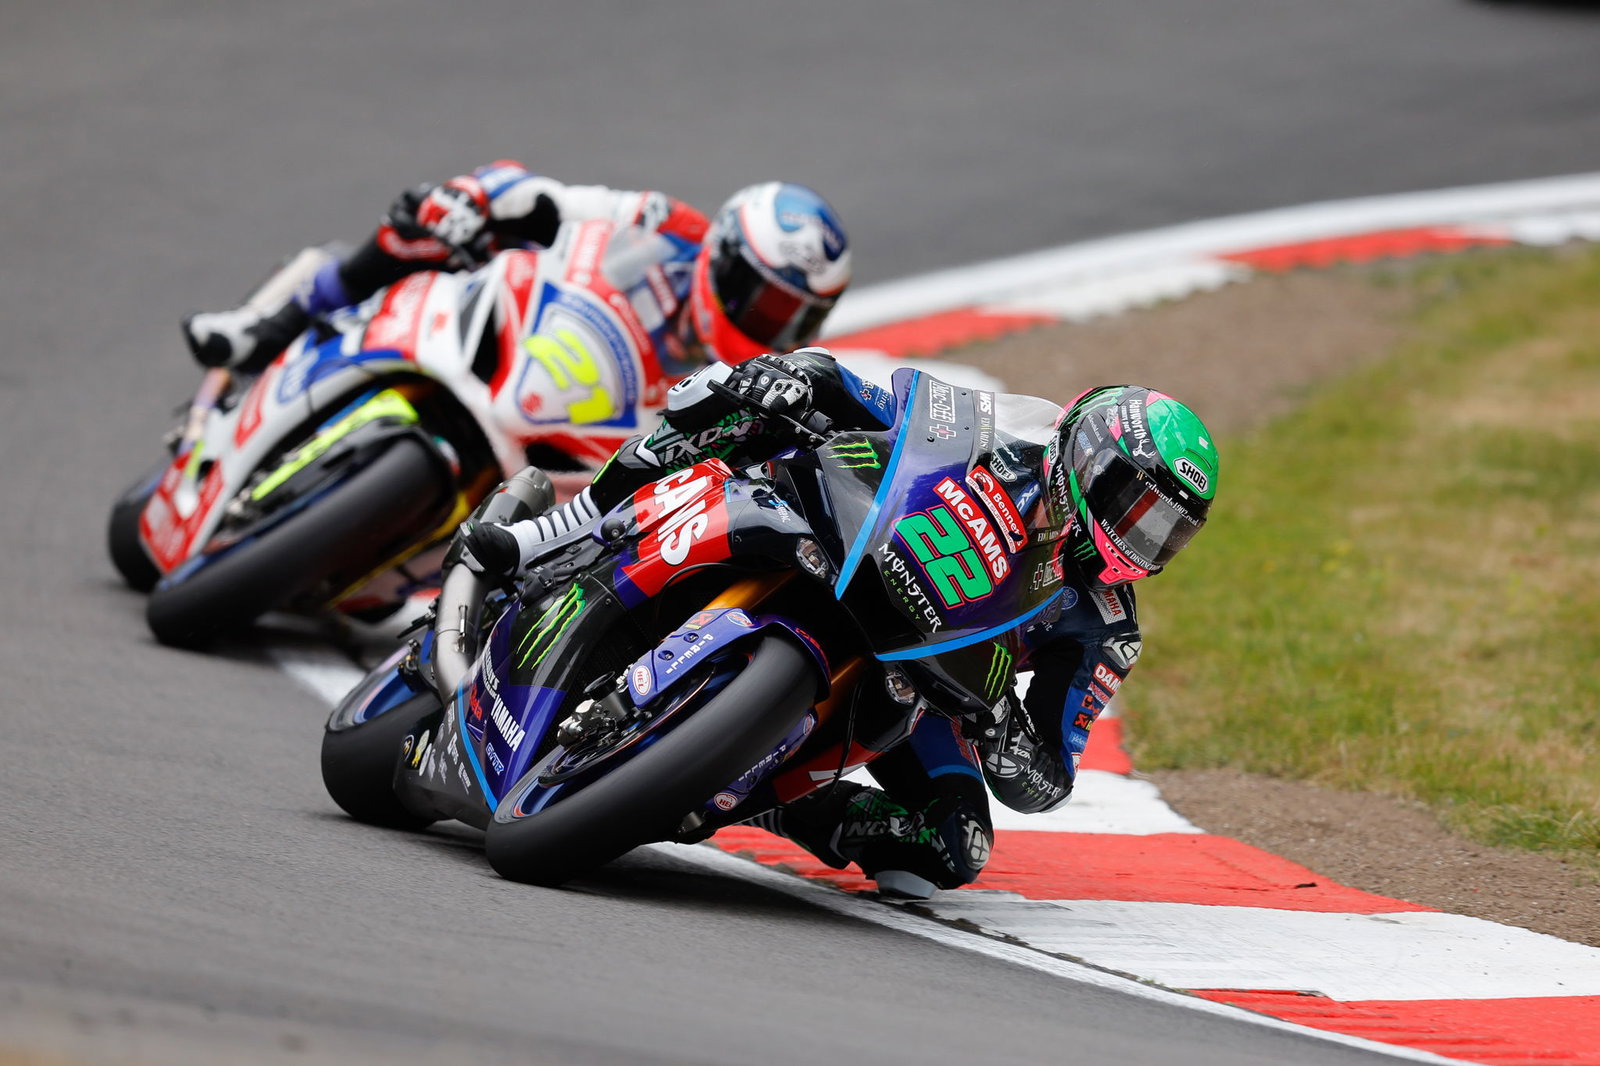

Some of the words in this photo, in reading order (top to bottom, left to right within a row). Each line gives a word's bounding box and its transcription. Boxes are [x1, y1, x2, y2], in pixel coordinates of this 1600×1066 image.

[521, 329, 615, 426] 21
[1180, 461, 1208, 490] SHOEI
[993, 492, 1023, 547] Bennets
[1100, 518, 1127, 553] WATCHES
[893, 506, 993, 607] 22
[878, 543, 942, 633] MONSTER
[883, 569, 921, 620] ENERGY
[1101, 589, 1124, 617] MAHA
[665, 633, 715, 675] PIRELLI
[490, 698, 526, 753] YAMAHA
